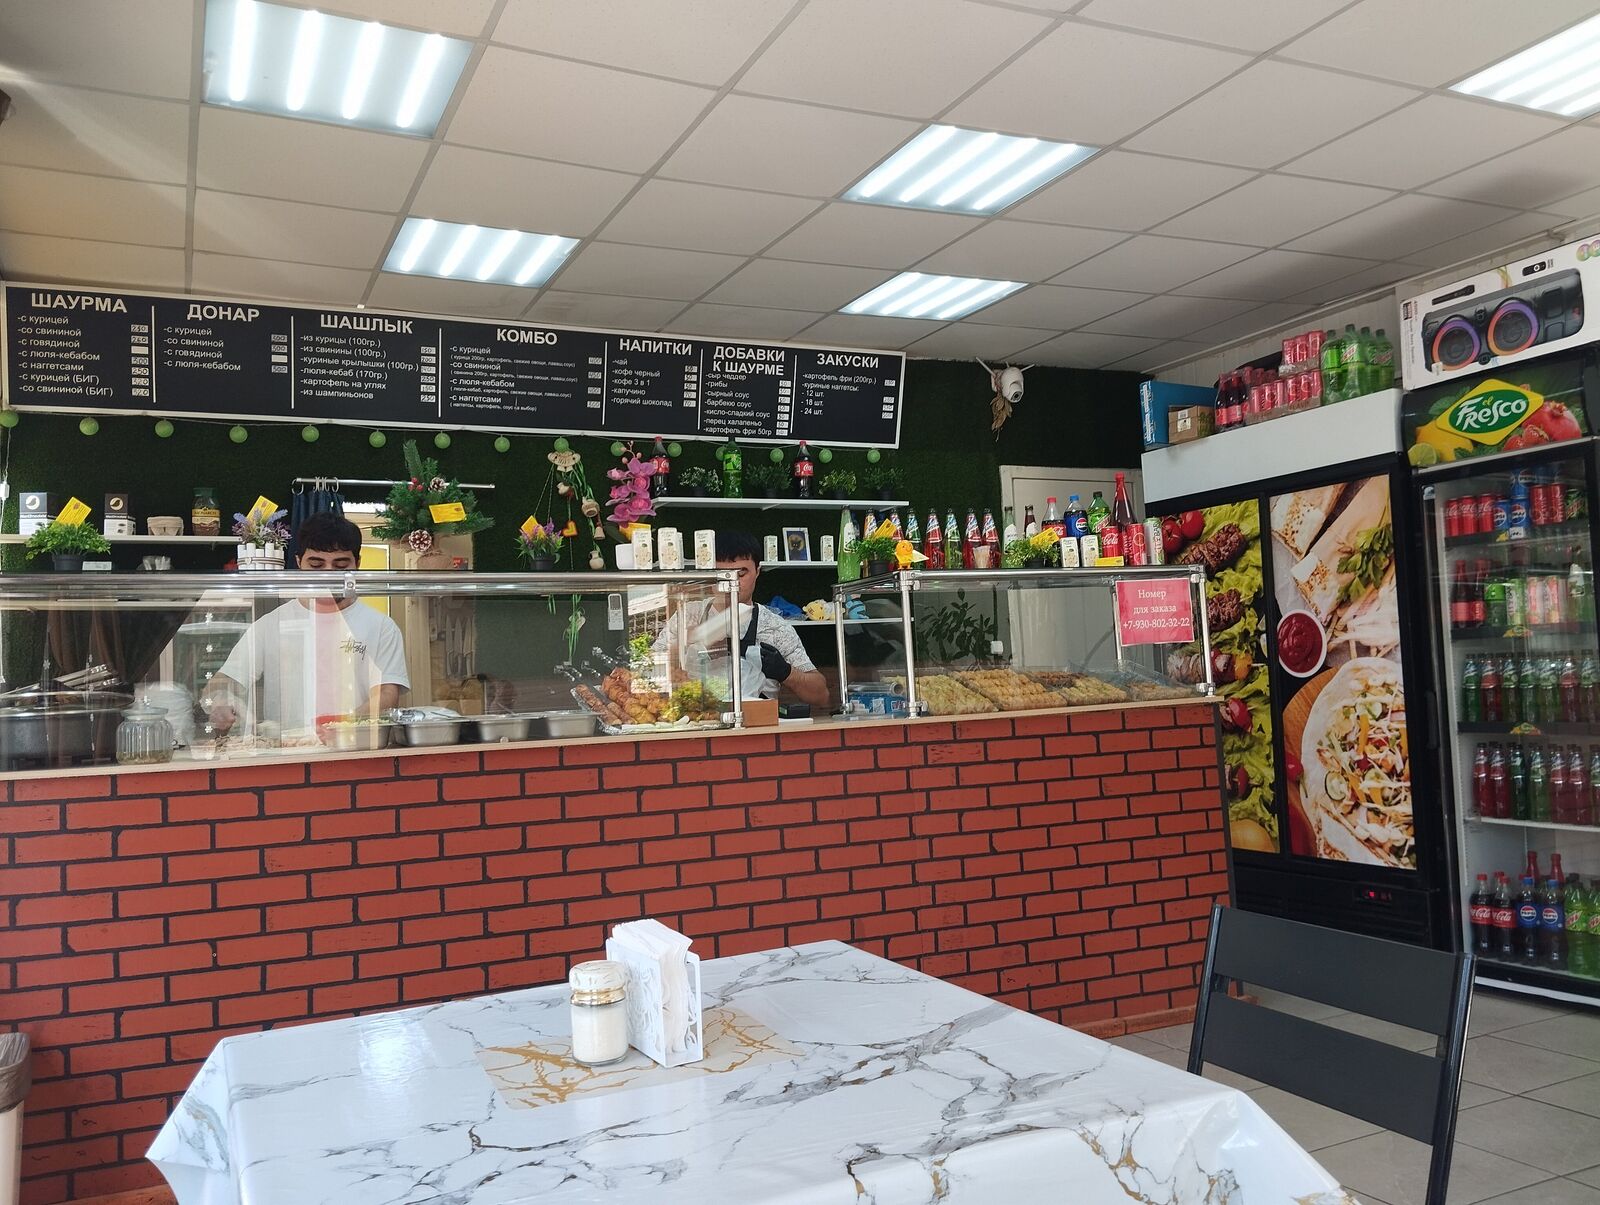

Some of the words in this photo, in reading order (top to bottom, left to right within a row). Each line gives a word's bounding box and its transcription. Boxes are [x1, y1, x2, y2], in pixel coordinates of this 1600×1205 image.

[32, 292, 128, 313] ШАУРМА
[187, 304, 260, 322] ДОНАР
[30, 316, 68, 324] курицей
[320, 314, 413, 334] ШАШЛЫК
[35, 328, 82, 336] свининой
[175, 327, 212, 336] курицей
[315, 336, 346, 344] курицы
[349, 338, 380, 348] (100гр.)
[496, 328, 558, 346] КОМБО
[30, 340, 80, 348] говядиной
[180, 338, 224, 348] свининой
[620, 338, 692, 356] НАПИТКИ
[30, 350, 100, 360] люля-кебабом
[175, 349, 222, 358] говядиной
[315, 346, 352, 355] свинины
[354, 348, 386, 358] (100гр.)
[713, 346, 785, 362] ДОБАВКИ
[300, 356, 339, 365] -куриные
[342, 359, 385, 368] крылышки
[387, 361, 419, 372] (100гр.)
[816, 353, 879, 368] ЗАКУСКИ
[31, 363, 84, 371] наггетсами
[175, 361, 240, 371] люля-кебабом
[713, 361, 721, 372] К
[725, 362, 784, 376] ШАУРМЕ
[300, 368, 353, 376] -люля-кебаб
[356, 370, 388, 380] (170гр.)
[612, 369, 632, 378] -кофе
[802, 373, 838, 381] -картофель
[854, 376, 876, 384] (200гр.)
[31, 374, 70, 383] курицей
[72, 374, 99, 385] (БИГ)
[300, 378, 349, 388] -картофель
[459, 379, 514, 388] люля-кебабом
[612, 379, 632, 388] -кофе
[37, 385, 82, 394] свининой
[86, 386, 113, 397] (БИГ)
[315, 390, 374, 399] шампиньонов
[704, 399, 735, 407] -барбекю
[703, 427, 741, 435] -картофель
[1138, 590, 1167, 599] Номер
[1133, 606, 1148, 614] для
[1123, 618, 1190, 629] +7-930-802-32-22
